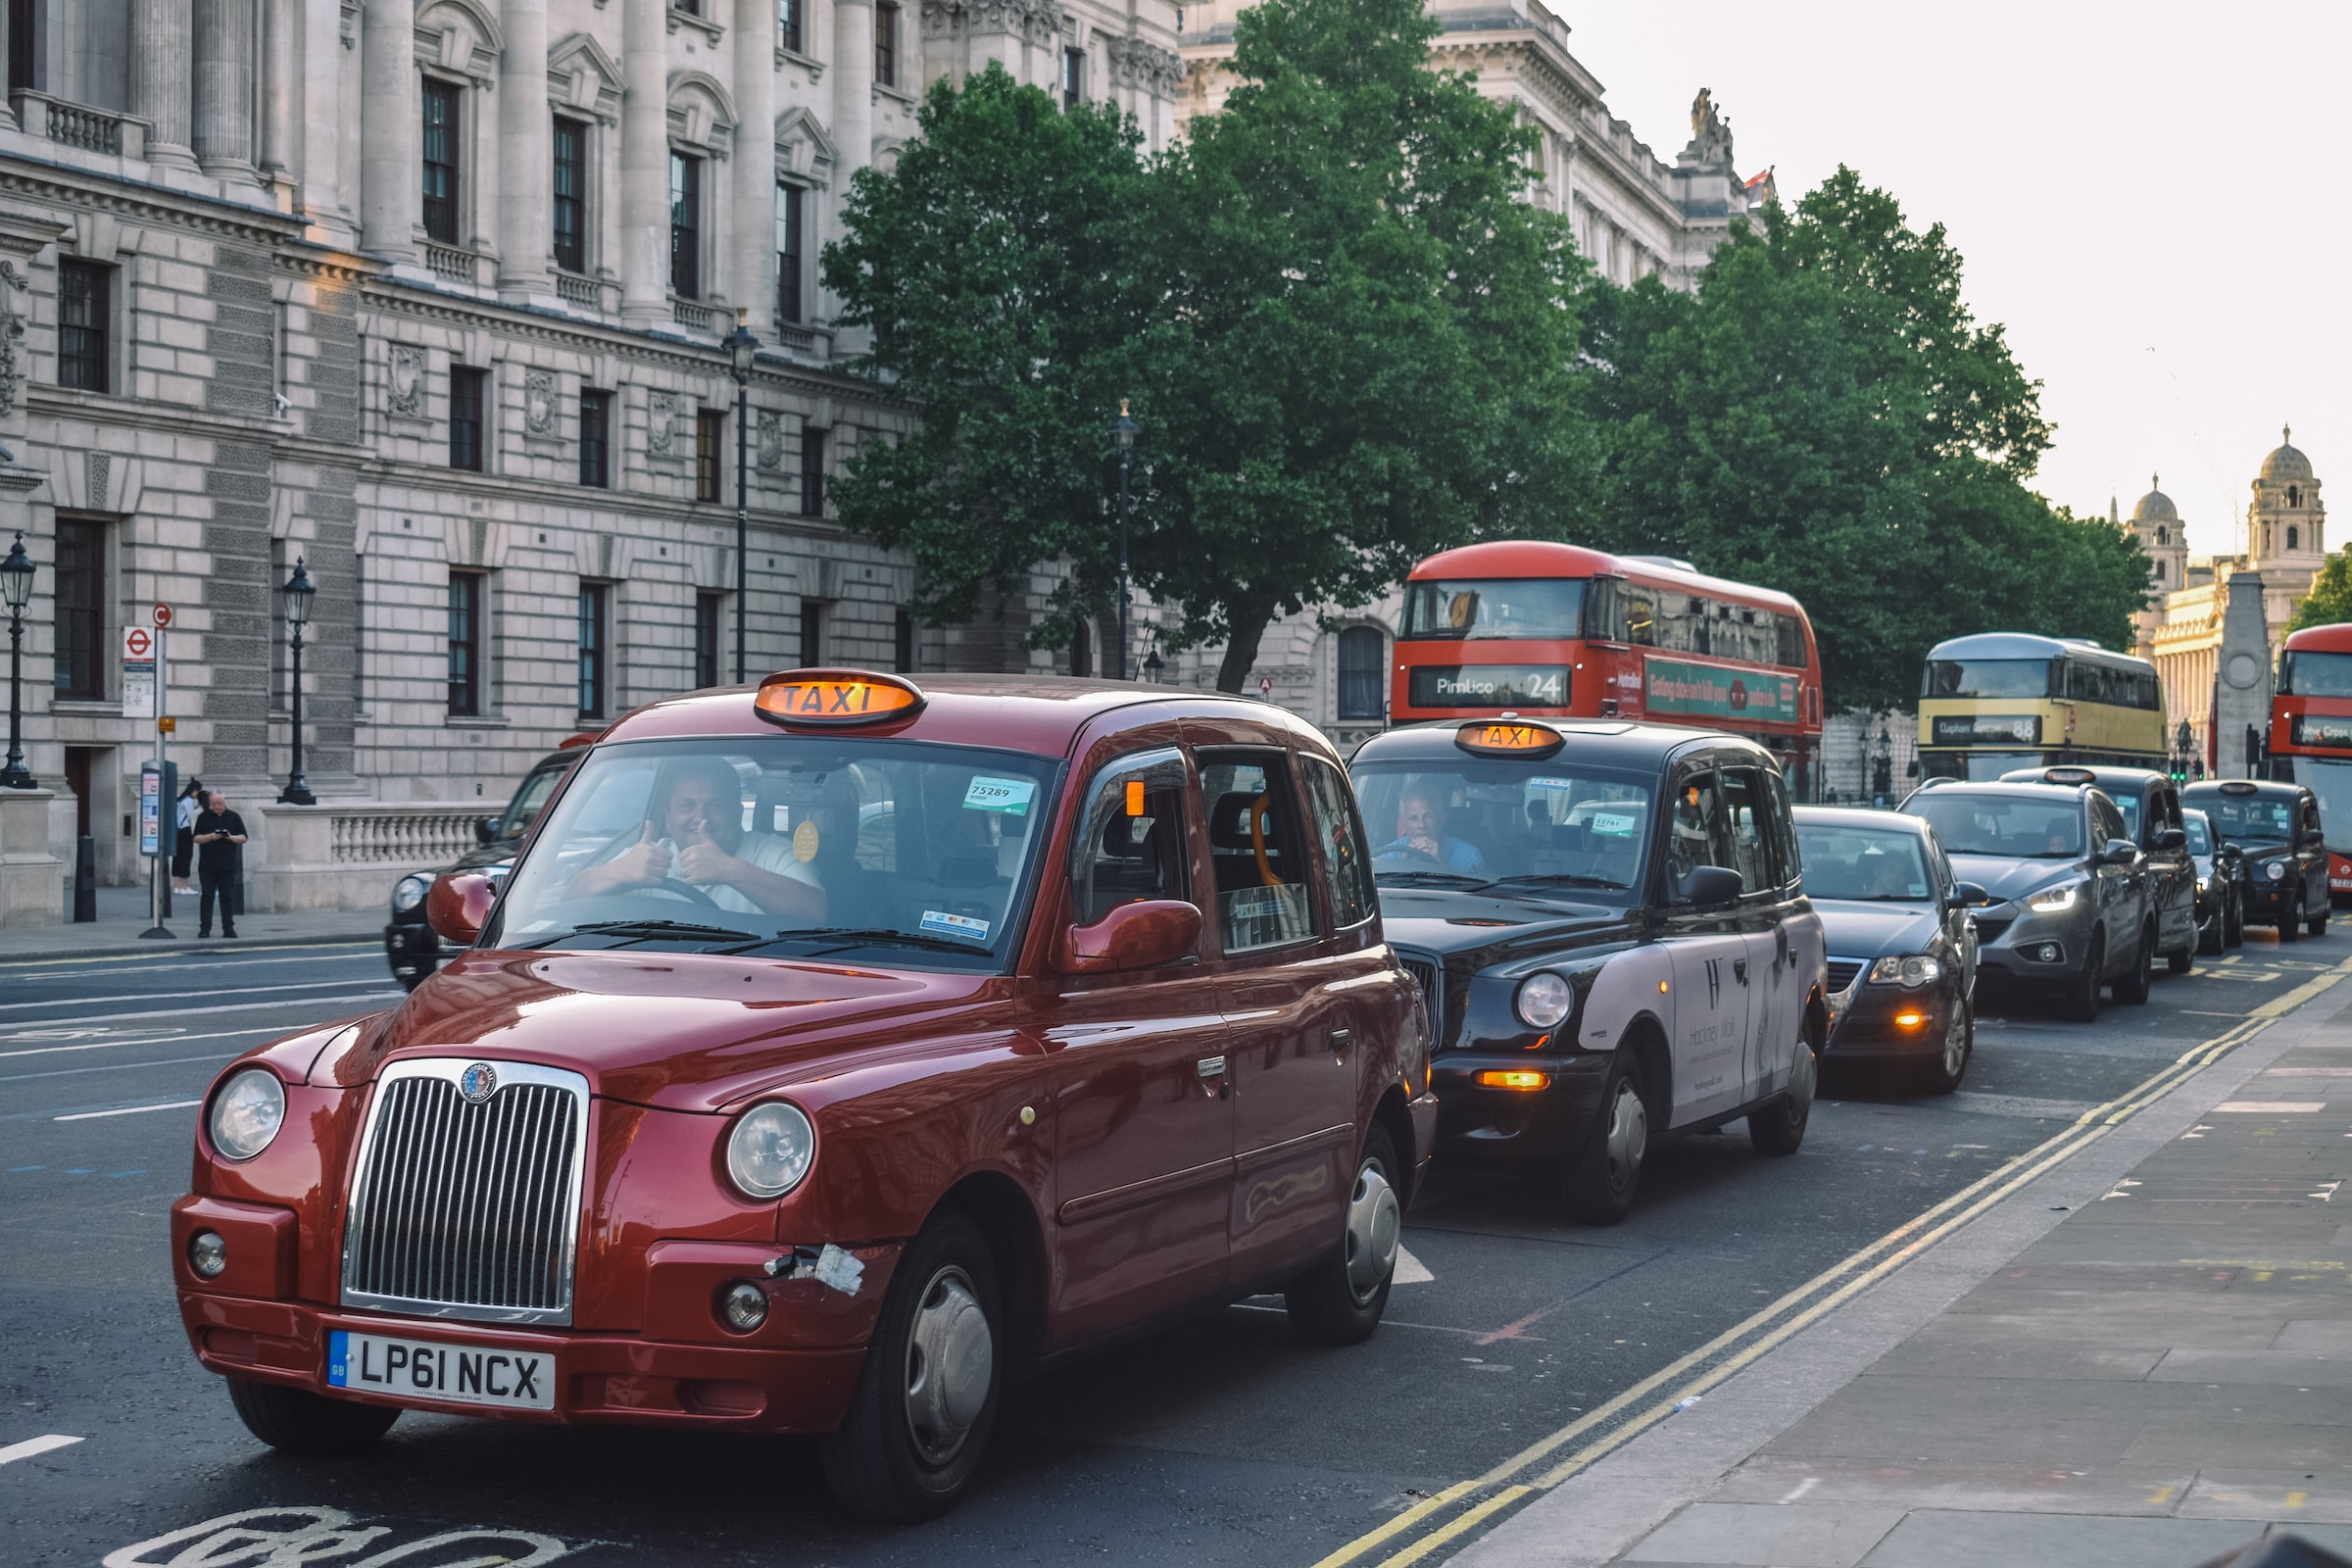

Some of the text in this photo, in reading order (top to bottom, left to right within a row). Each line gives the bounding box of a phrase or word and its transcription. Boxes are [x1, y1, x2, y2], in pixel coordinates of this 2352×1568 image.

[155, 608, 166, 623] C
[1261, 678, 1270, 689] A
[1437, 674, 1561, 698] Pimlico 24
[1650, 674, 1675, 703] Eating
[783, 686, 871, 712] TAXI
[1475, 727, 1536, 745] TAXI
[1939, 722, 1970, 734] Clapham
[2012, 720, 2034, 737] 88
[2300, 725, 2348, 736] New Cross
[972, 786, 1010, 798] 75289
[1690, 1026, 1716, 1047] Hackney
[332, 1364, 345, 1376] GB
[362, 1341, 539, 1399] LP61 NCX
